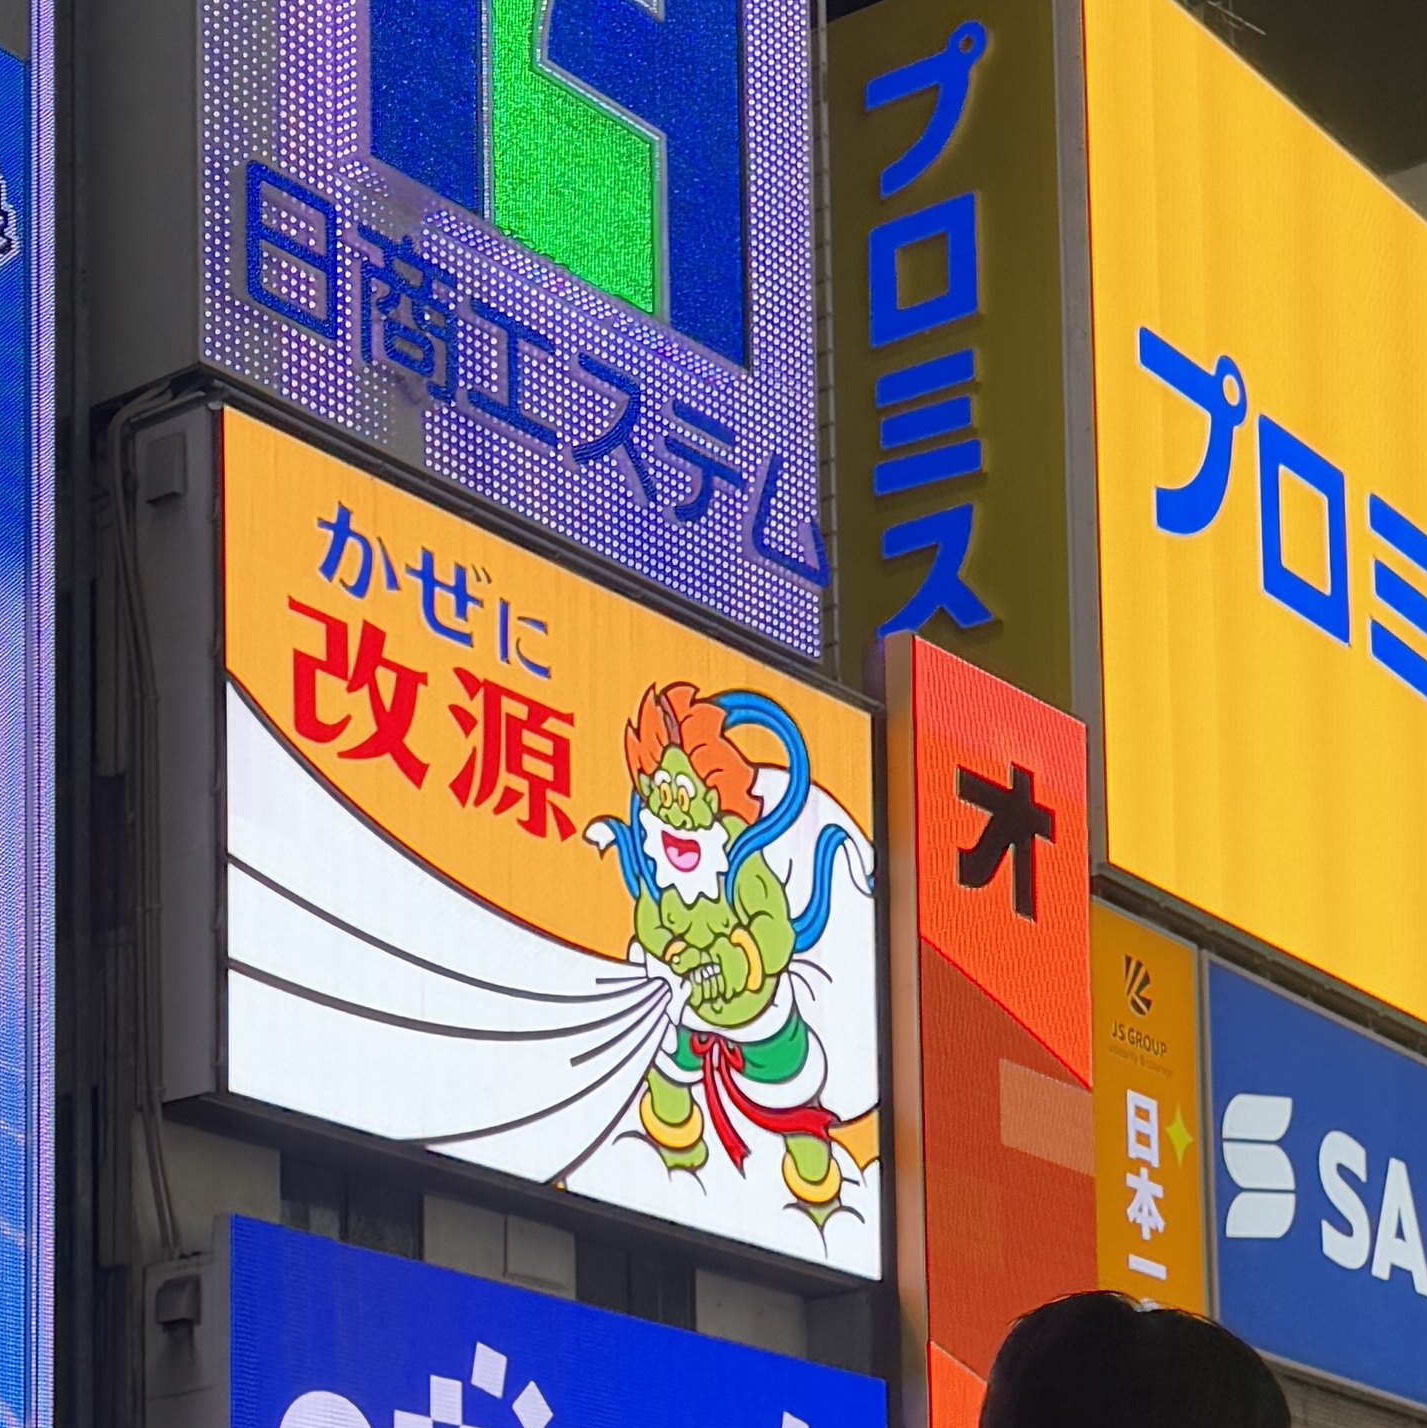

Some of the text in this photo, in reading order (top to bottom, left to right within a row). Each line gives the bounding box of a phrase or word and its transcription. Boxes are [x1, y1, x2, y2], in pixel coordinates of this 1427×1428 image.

[246, 158, 829, 590] 日商エステム
[863, 19, 994, 638] プロミス
[317, 500, 552, 679] かぜに
[286, 594, 577, 843] 改源
[955, 761, 1057, 923] オ
[1111, 1020, 1168, 1058] JS GROUP
[1125, 1089, 1168, 1312] 日本一
